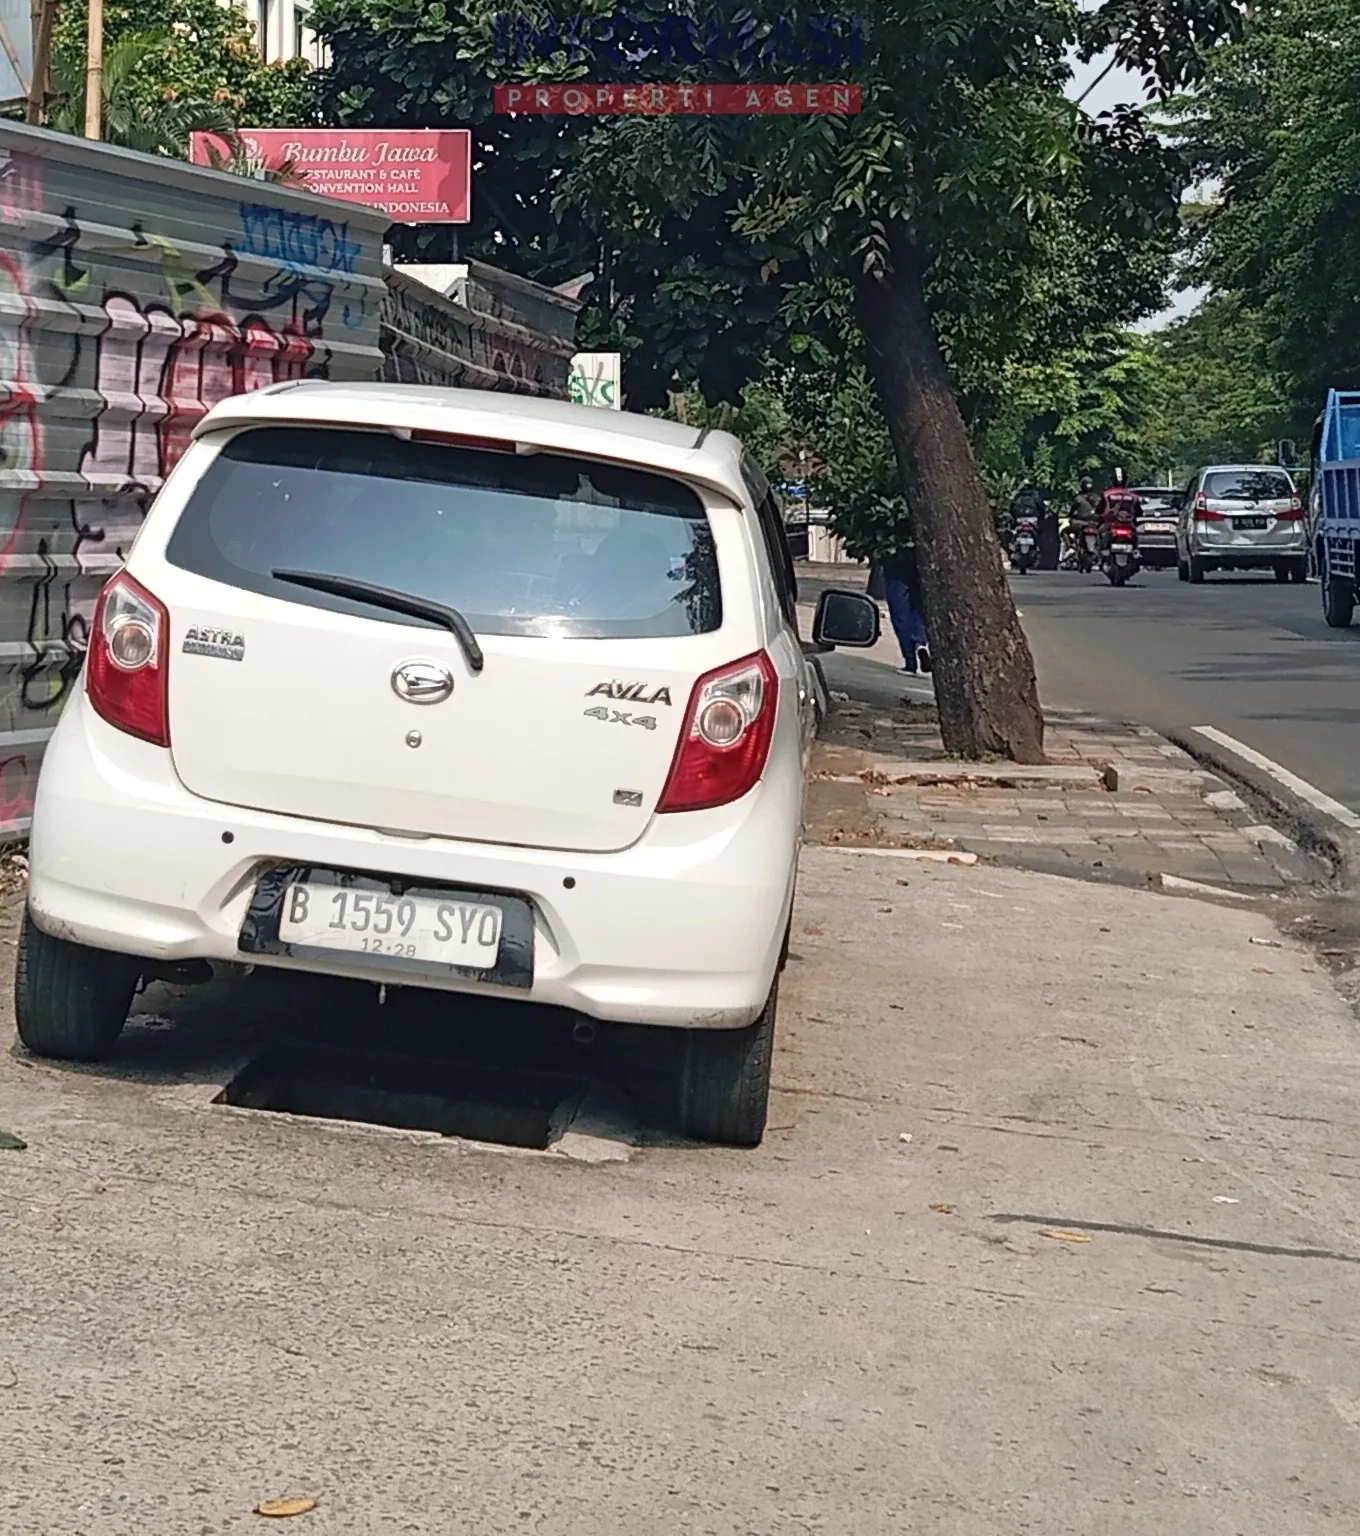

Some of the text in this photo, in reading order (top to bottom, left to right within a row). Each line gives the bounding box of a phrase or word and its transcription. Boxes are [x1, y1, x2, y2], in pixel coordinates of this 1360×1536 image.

[281, 140, 370, 163] Bumbu
[371, 142, 438, 166] Jawa
[390, 168, 421, 180] CAFÉ
[303, 183, 419, 194] ONVENTION HALL
[185, 625, 244, 647] ASTRA
[289, 886, 498, 947] B 1559 SYO
